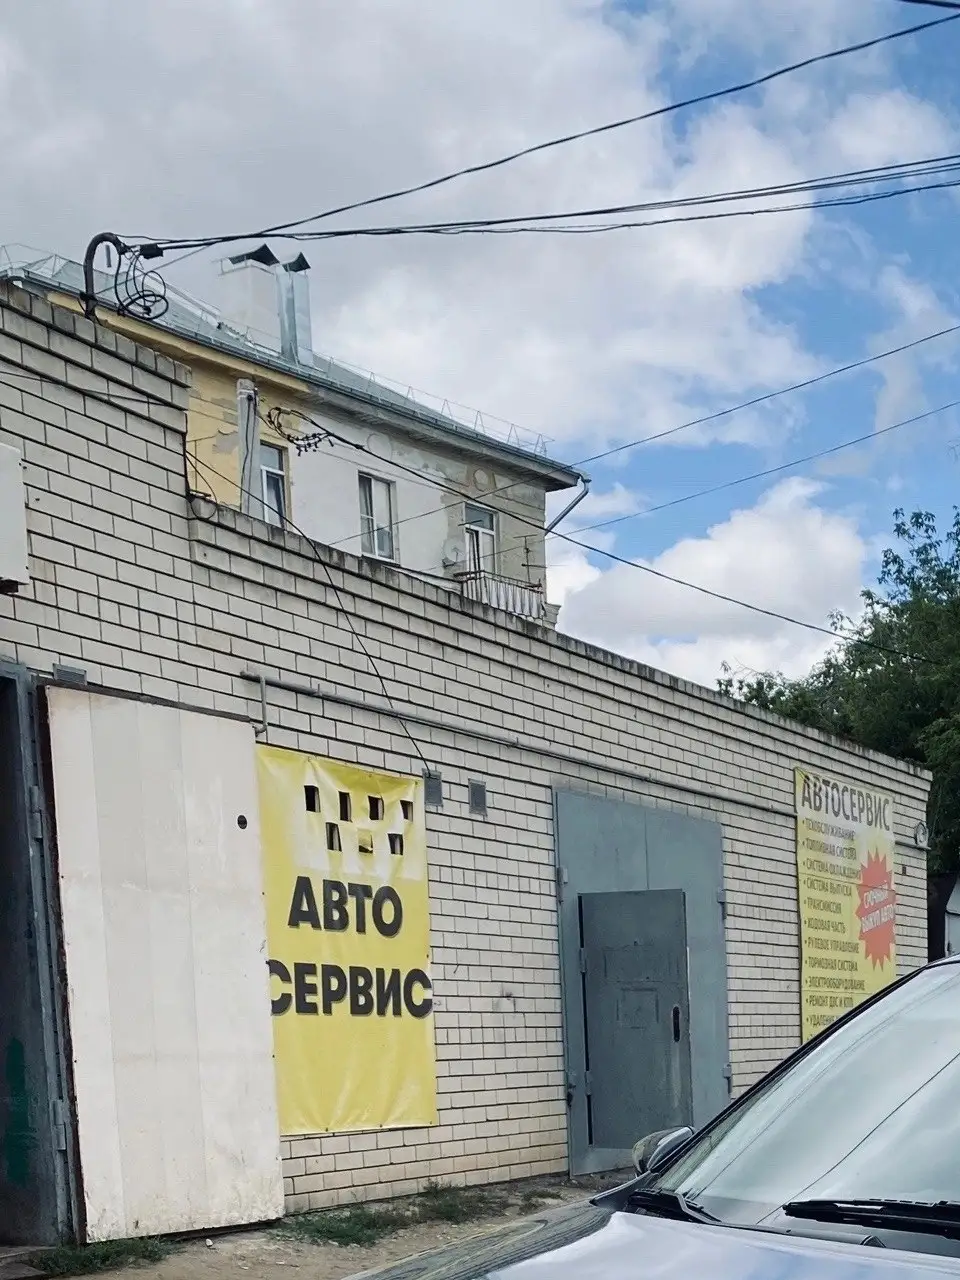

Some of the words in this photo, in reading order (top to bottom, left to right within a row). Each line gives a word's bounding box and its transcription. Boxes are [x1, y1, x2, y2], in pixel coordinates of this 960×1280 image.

[801, 774, 890, 831] АВТОСЕРВИС
[836, 846, 857, 860] СИСТЕМА
[806, 858, 829, 873] СИСТЕМА
[806, 877, 829, 893] СИСТЕМА
[830, 882, 852, 897] ВЫПУСКА
[287, 875, 403, 938] АВТО
[807, 897, 842, 914] ТРАНСМИССИЯ
[807, 917, 831, 932] ХОДОВАЯ
[831, 921, 846, 934] ЧАСТЬ
[808, 937, 830, 950] РУЛЕВОЕ
[830, 940, 860, 954] УПРАВЛЕНИЕ
[808, 957, 837, 971] ТОРМОЗНАЯ
[837, 959, 859, 972] СИСТЕМА
[266, 959, 433, 1019] СЕРВИС
[808, 976, 866, 991] ЭЛЕКТРООБОРУДОВАНИЕ
[809, 995, 828, 1007] РЕМОНТ
[829, 995, 839, 1007] ДВС
[839, 996, 843, 1007] И
[844, 996, 854, 1008] КПП
